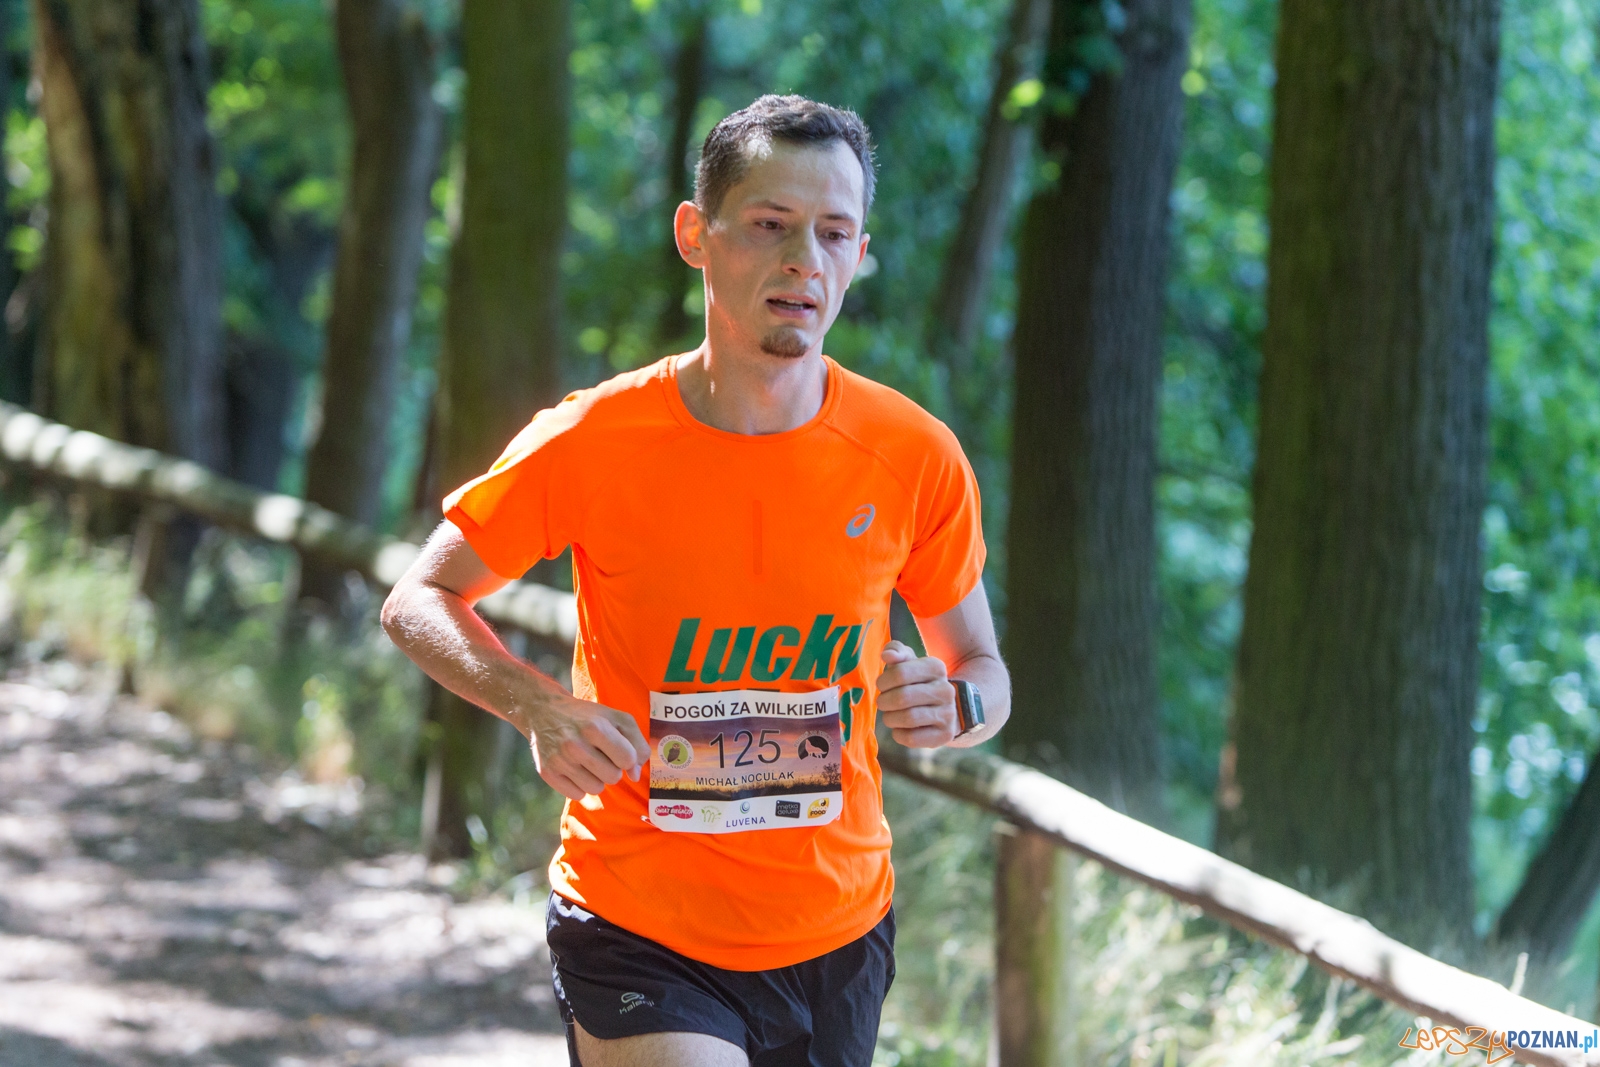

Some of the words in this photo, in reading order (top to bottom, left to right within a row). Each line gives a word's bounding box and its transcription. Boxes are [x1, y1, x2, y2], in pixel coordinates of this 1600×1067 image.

[663, 614, 874, 686] Lucky
[664, 701, 725, 719] POGOŃ
[730, 702, 751, 716] ZA
[755, 701, 827, 716] WILKIEM
[709, 729, 781, 769] 125
[695, 776, 739, 786] MICHAŁ
[741, 771, 794, 784] NOCULAK
[726, 816, 766, 828] LUVENA
